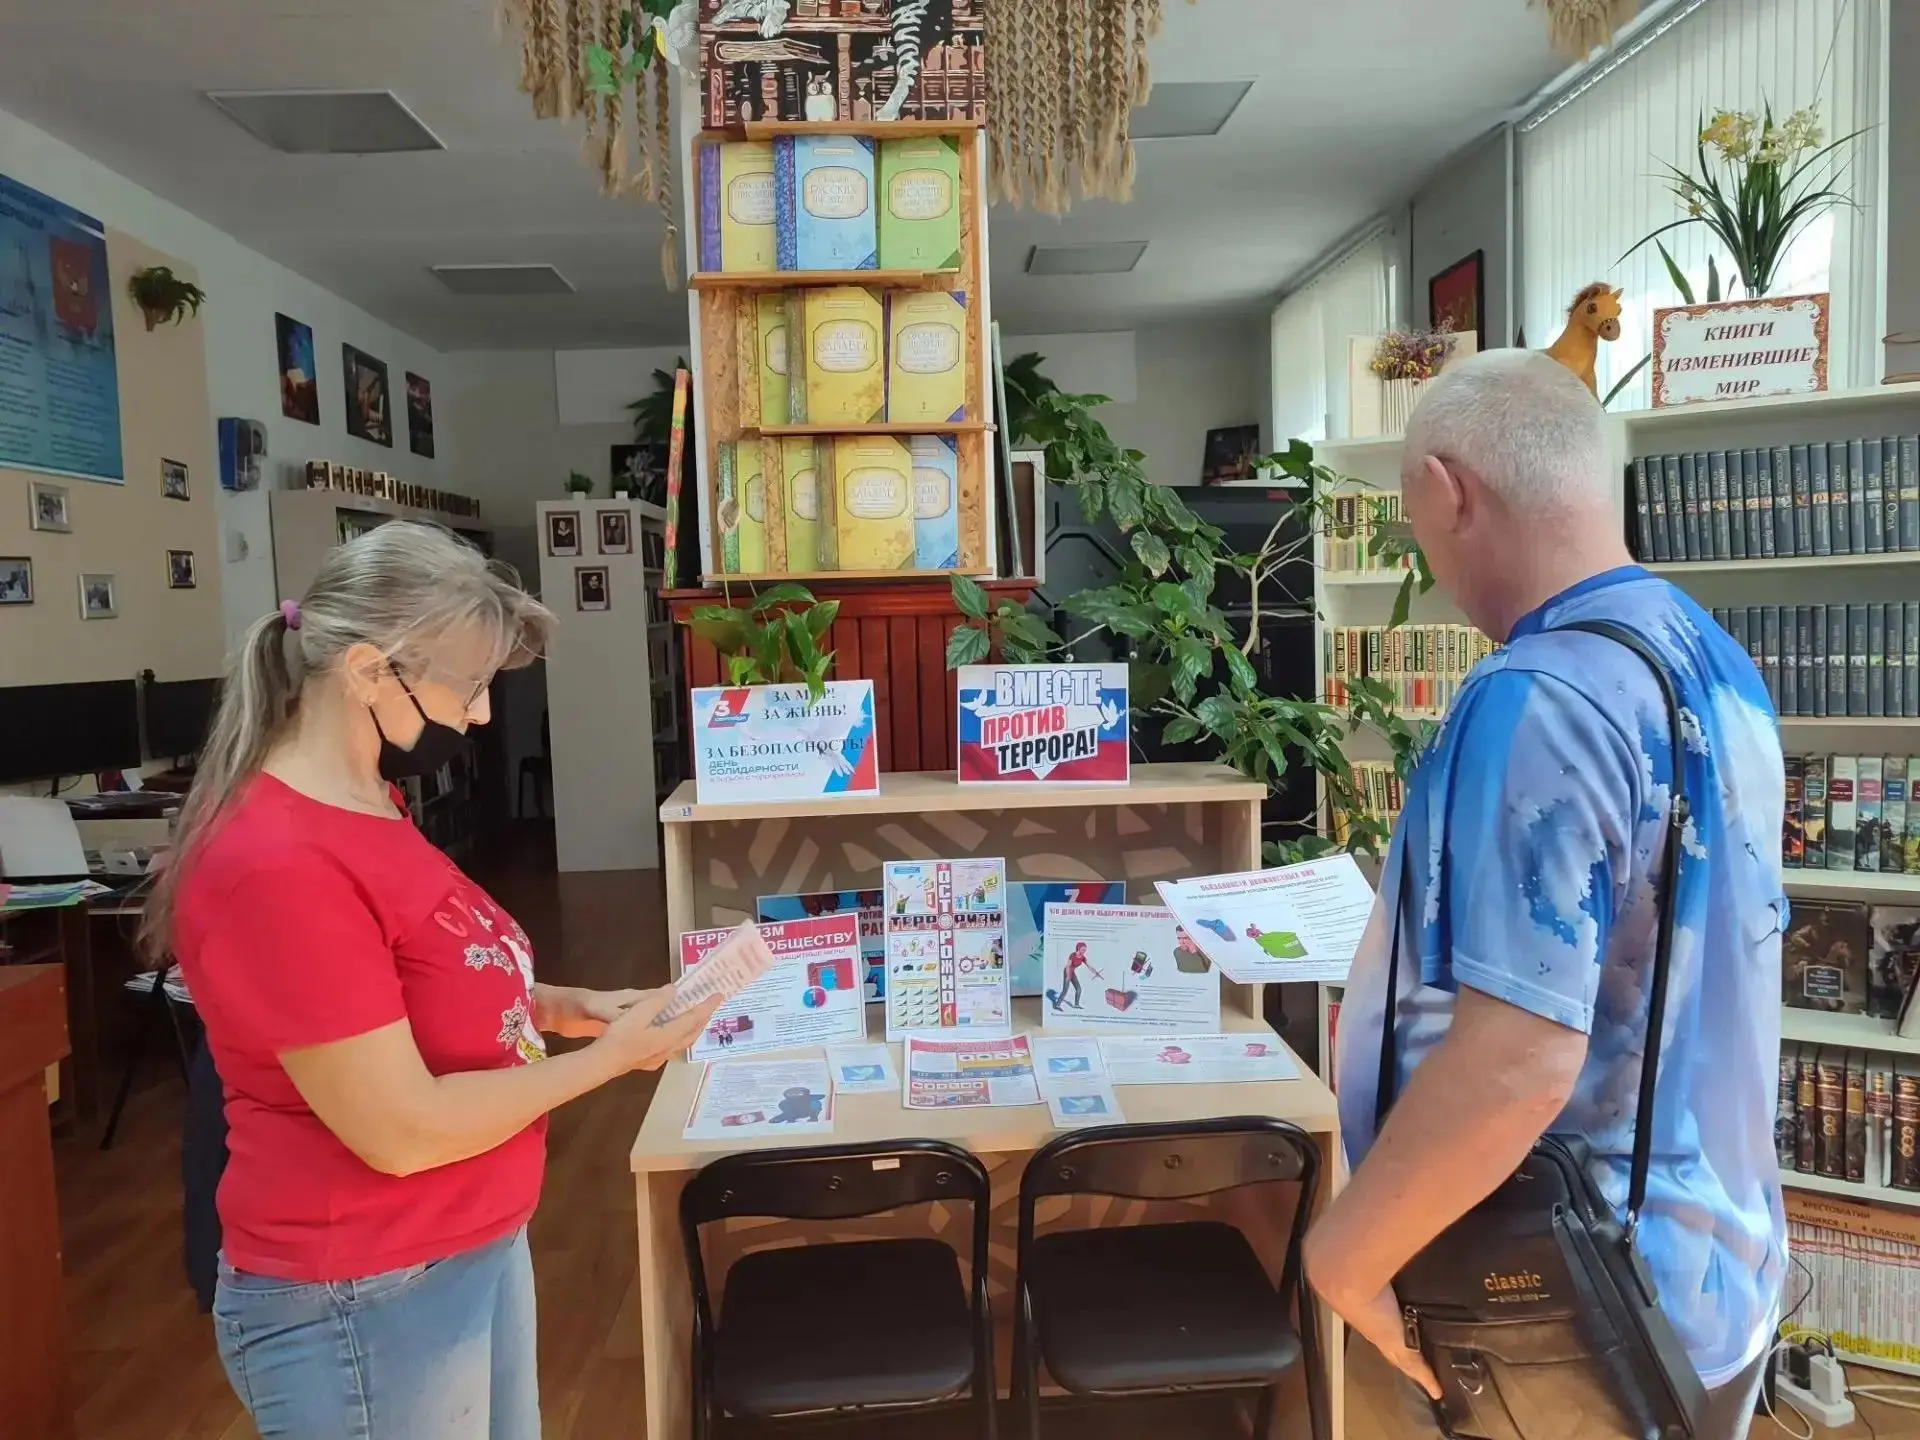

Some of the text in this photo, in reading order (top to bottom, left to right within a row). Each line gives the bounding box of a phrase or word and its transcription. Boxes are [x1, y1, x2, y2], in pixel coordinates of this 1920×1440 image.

[1704, 322, 1775, 341] КНИГИ
[1666, 347, 1815, 373] ИЗМЕНИВШИЕ
[1716, 380, 1760, 395] МИР
[771, 687, 835, 702] ЗА МР!
[995, 670, 1102, 706] ВМЕСТЕ
[714, 700, 731, 716] 3
[761, 704, 847, 720] ЗА ЖИЗНЬ!
[984, 705, 1065, 745] ПРОТИВ
[705, 738, 865, 759] ЗА БЕЗОПАСНОСТЬ!
[998, 728, 1095, 770] ТЕРРОРА!
[709, 760, 738, 769] ДЕНЬ
[709, 763, 799, 776] СОЛИДАРНОСТИ
[1061, 908, 1082, 916] ДЕЛАТЬ
[767, 931, 853, 951] ОБЩЕСТВУ
[1788, 1212, 1840, 1227] УЧАЩИХСЯ
[1871, 1226, 1917, 1241] КЛАССОВ
[1484, 1270, 1543, 1291] classic
